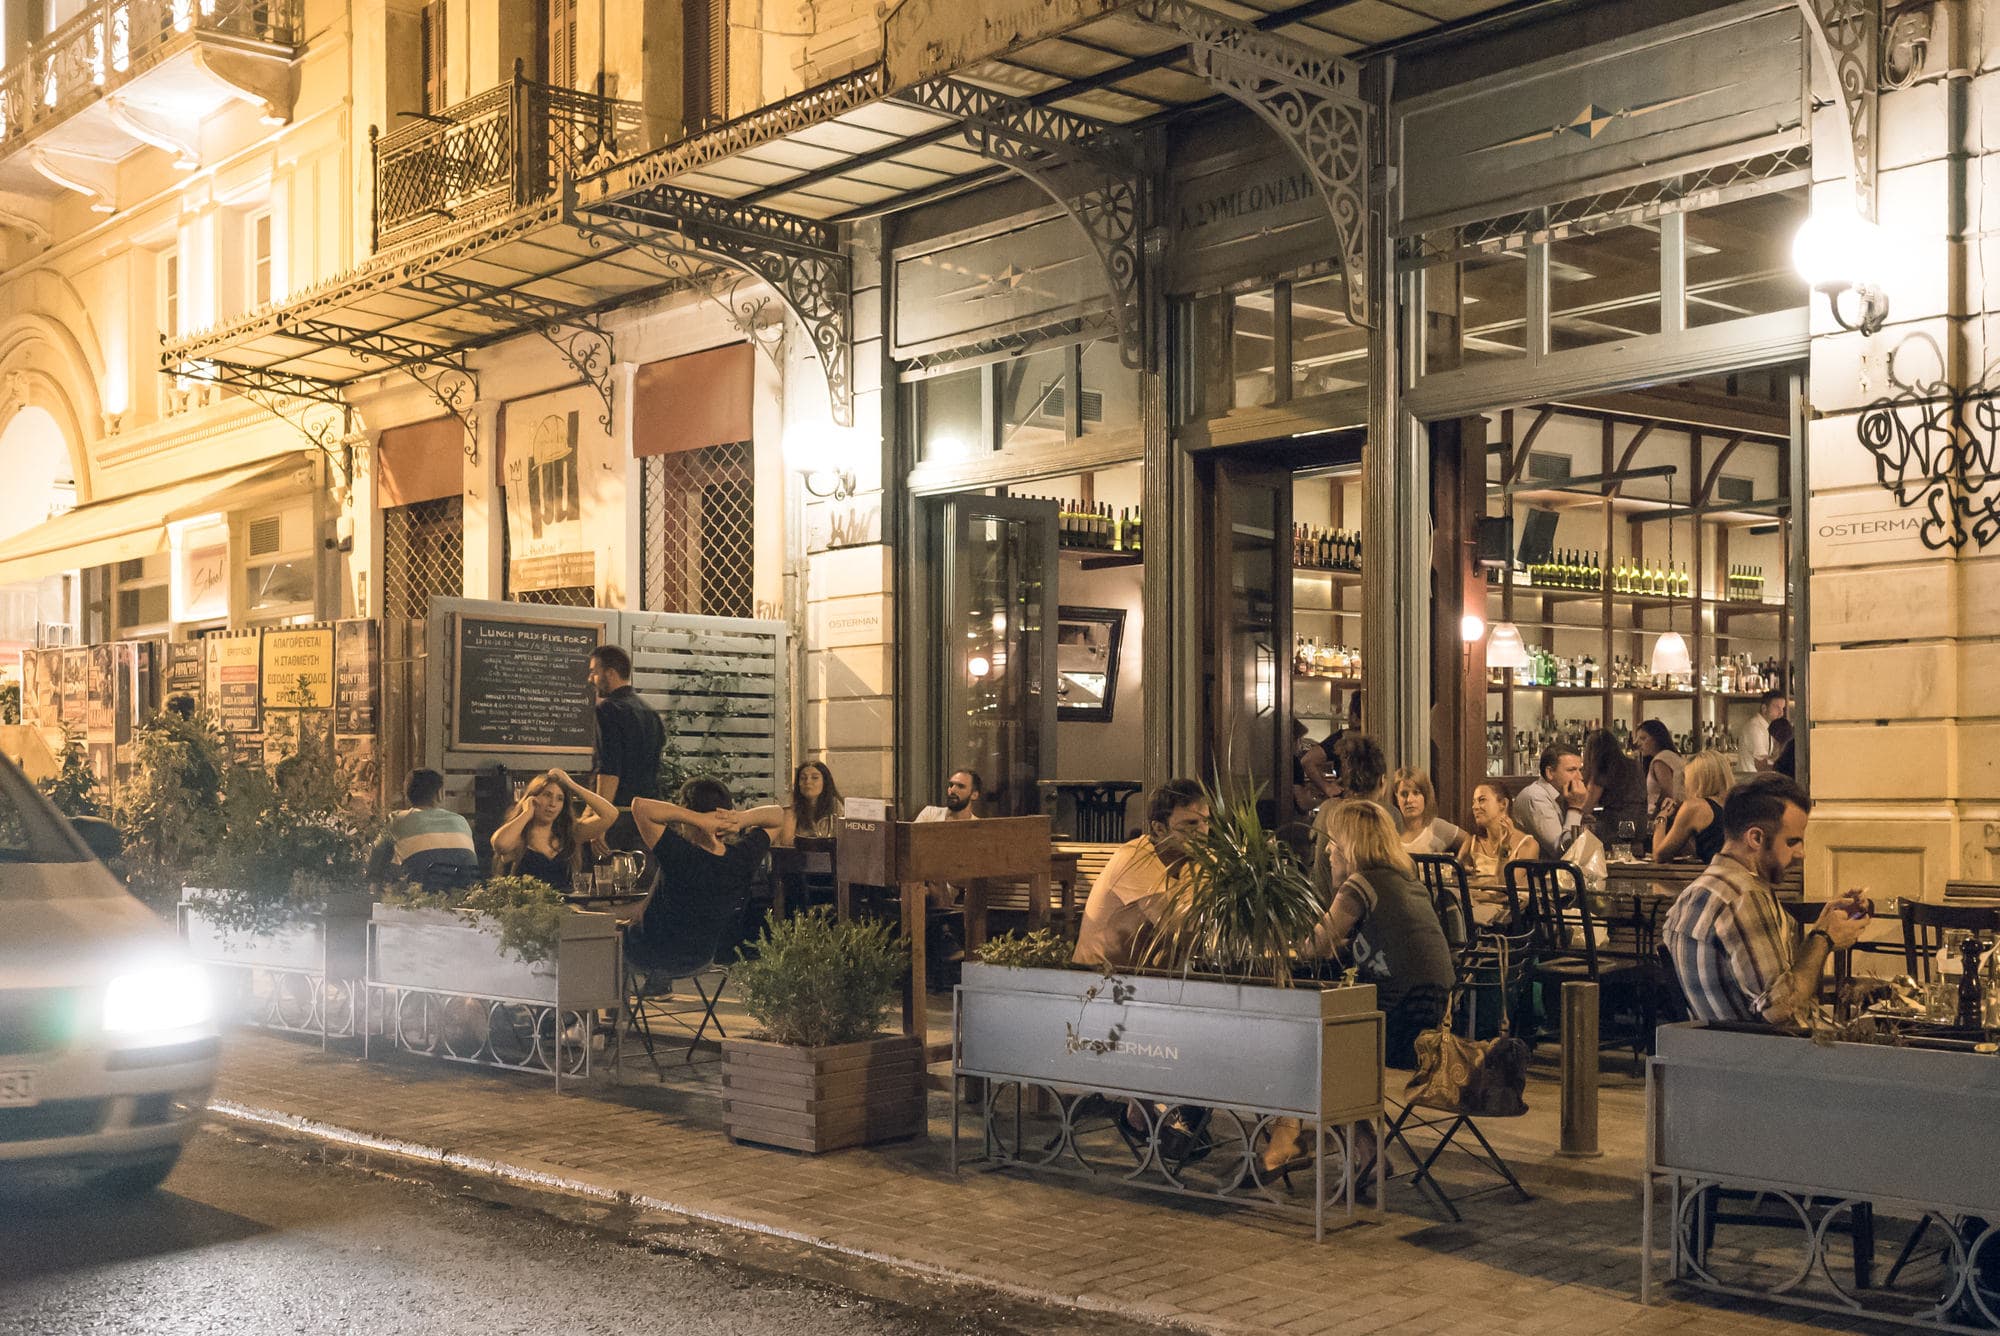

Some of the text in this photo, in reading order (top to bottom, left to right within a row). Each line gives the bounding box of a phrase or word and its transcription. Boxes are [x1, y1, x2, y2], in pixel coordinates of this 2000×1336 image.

[1818, 516, 1937, 538] OSTERMA
[828, 616, 879, 629] OSTERMAN
[480, 626, 514, 638] LUNCH
[563, 635, 580, 643] FOR
[580, 635, 588, 644] 2
[845, 822, 875, 831] MENUS
[1079, 1037, 1178, 1060] ERMAN
